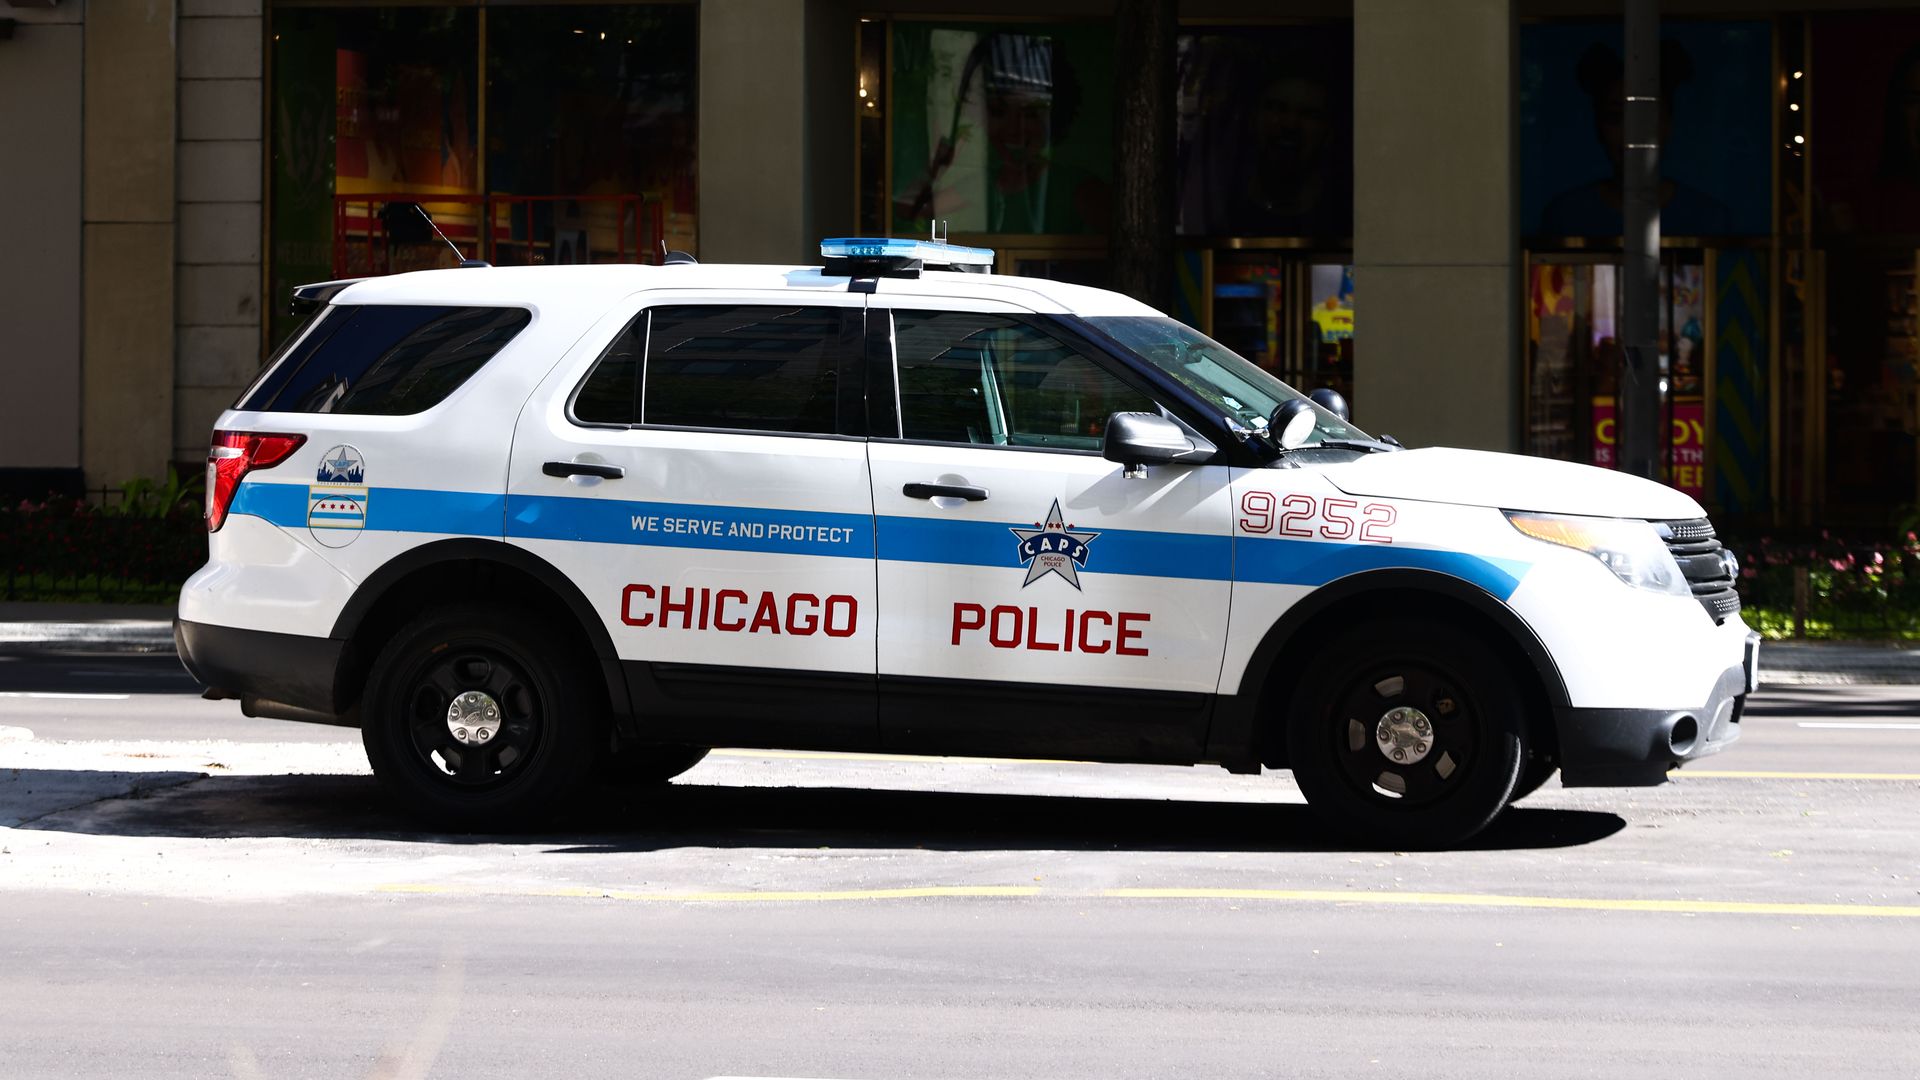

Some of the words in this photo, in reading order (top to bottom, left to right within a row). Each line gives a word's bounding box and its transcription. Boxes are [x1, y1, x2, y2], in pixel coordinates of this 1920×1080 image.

[1595, 418, 1704, 445] CDY
[1595, 448, 1610, 462] IS
[1682, 448, 1704, 463] TH
[631, 515, 659, 532] WE
[663, 517, 724, 537] SERVE
[727, 522, 764, 539] AND
[768, 524, 854, 544] PROTECT
[1239, 490, 1398, 544] 9252
[1024, 537, 1084, 558] CAPS
[620, 583, 858, 638] CHICAGO
[951, 602, 1152, 657] POLICE
